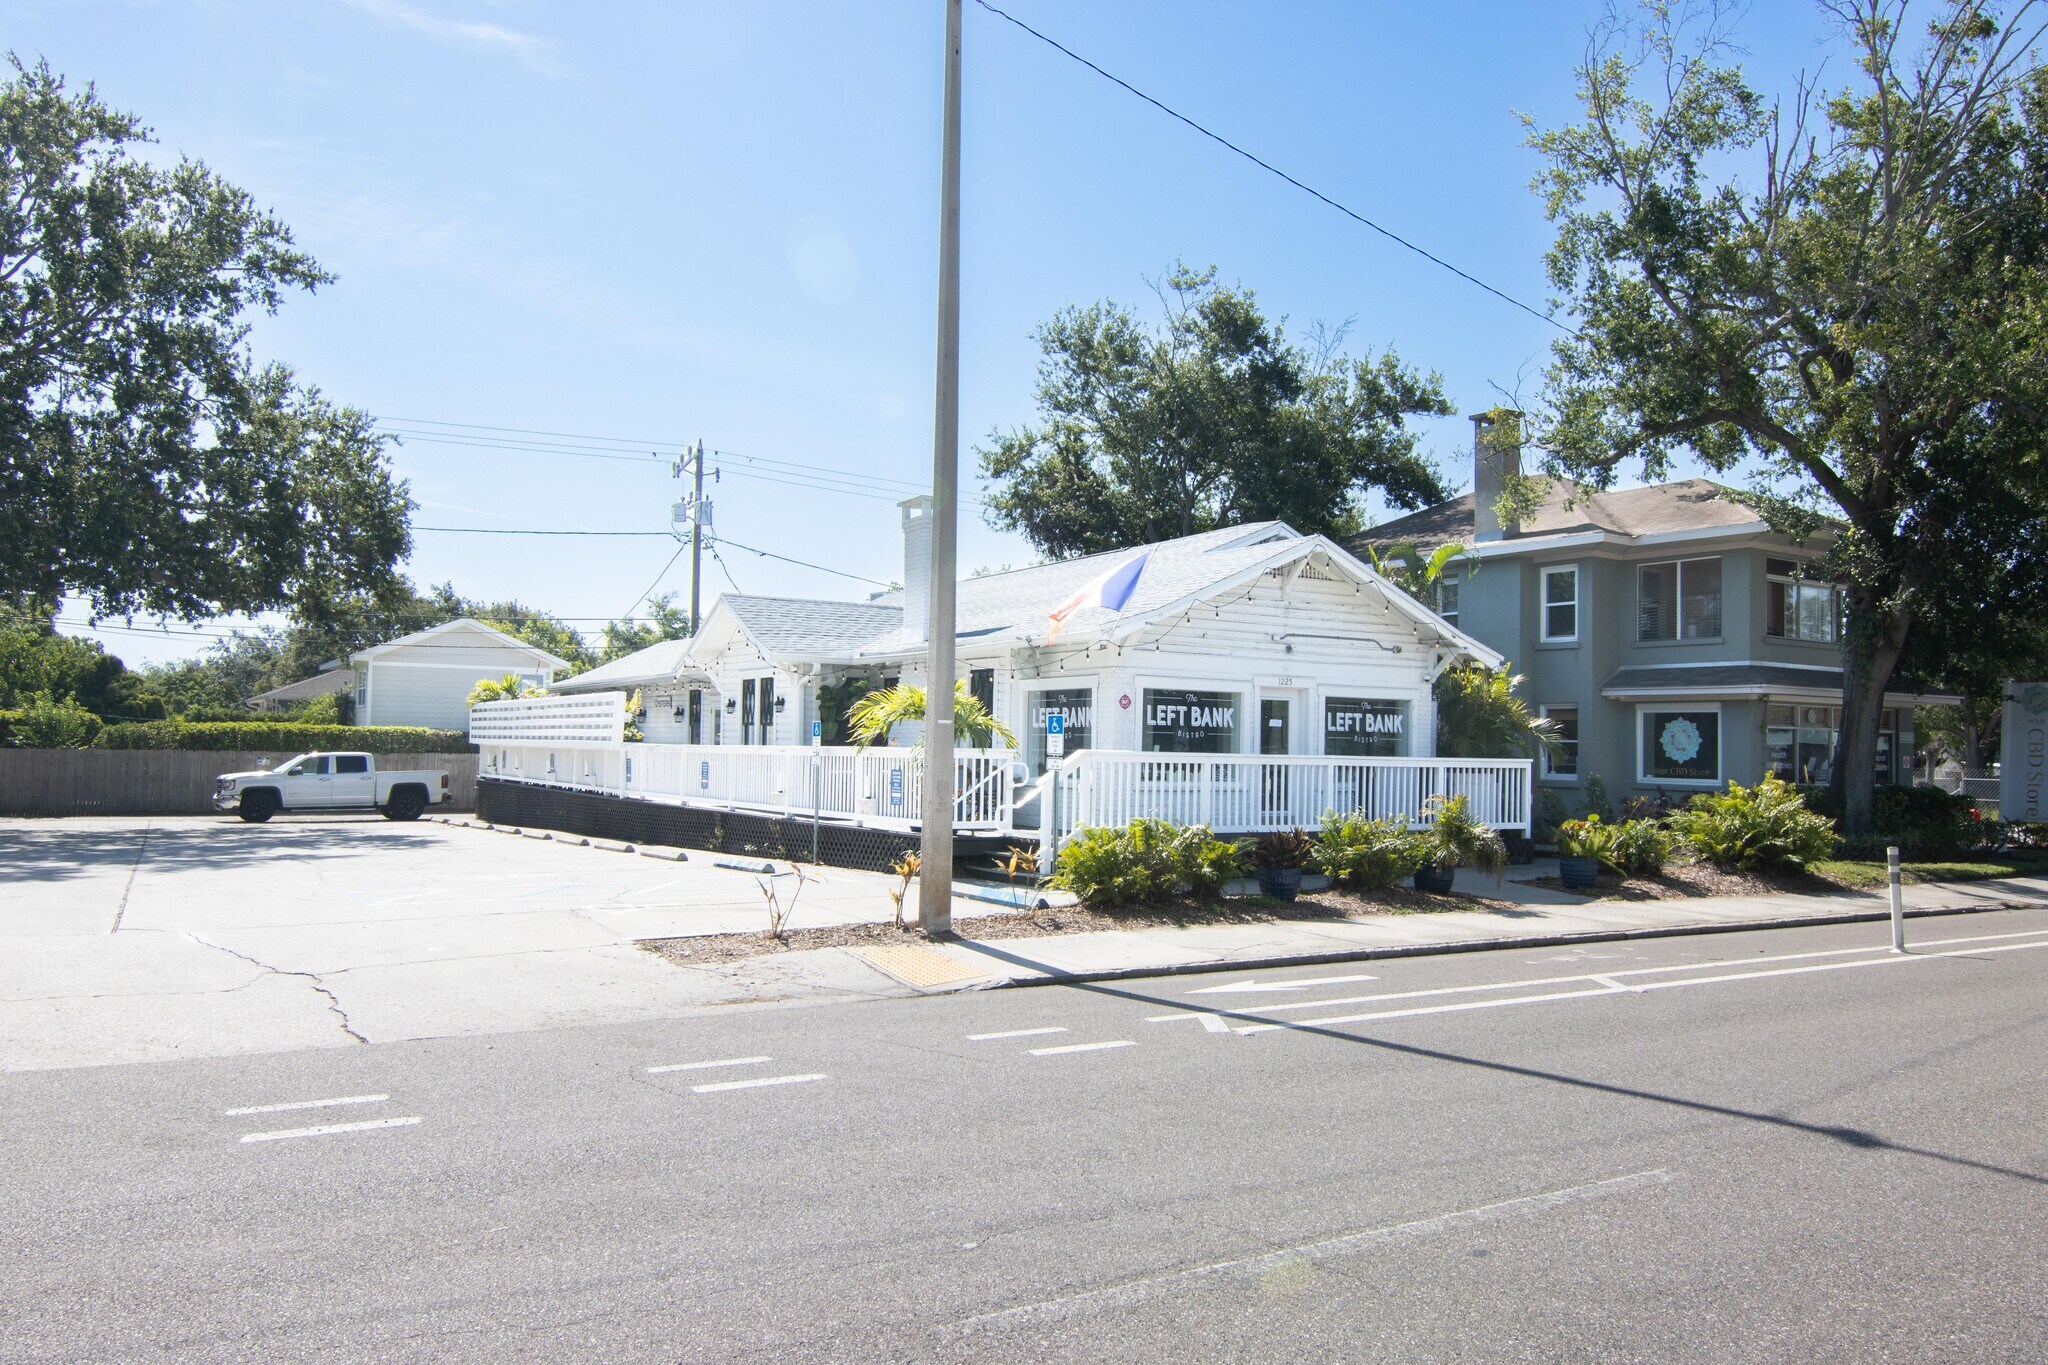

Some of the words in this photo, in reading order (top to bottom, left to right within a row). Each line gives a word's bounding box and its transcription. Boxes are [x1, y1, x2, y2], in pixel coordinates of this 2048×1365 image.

[1278, 677, 1293, 686] 1225
[1058, 694, 1068, 703] The
[1185, 693, 1198, 703] The
[1360, 701, 1373, 710] The
[1146, 704, 1188, 726] LEFT
[1191, 706, 1235, 728] BANK
[1328, 712, 1362, 732] LEFT
[1366, 714, 1403, 733] BANK
[1177, 729, 1205, 739] BISTRO
[1353, 735, 1378, 744] BISTRO
[2028, 728, 2044, 767] CBD
[1670, 766, 1688, 776] CBD
[1689, 767, 1710, 777] Store
[2026, 772, 2043, 816] Store
